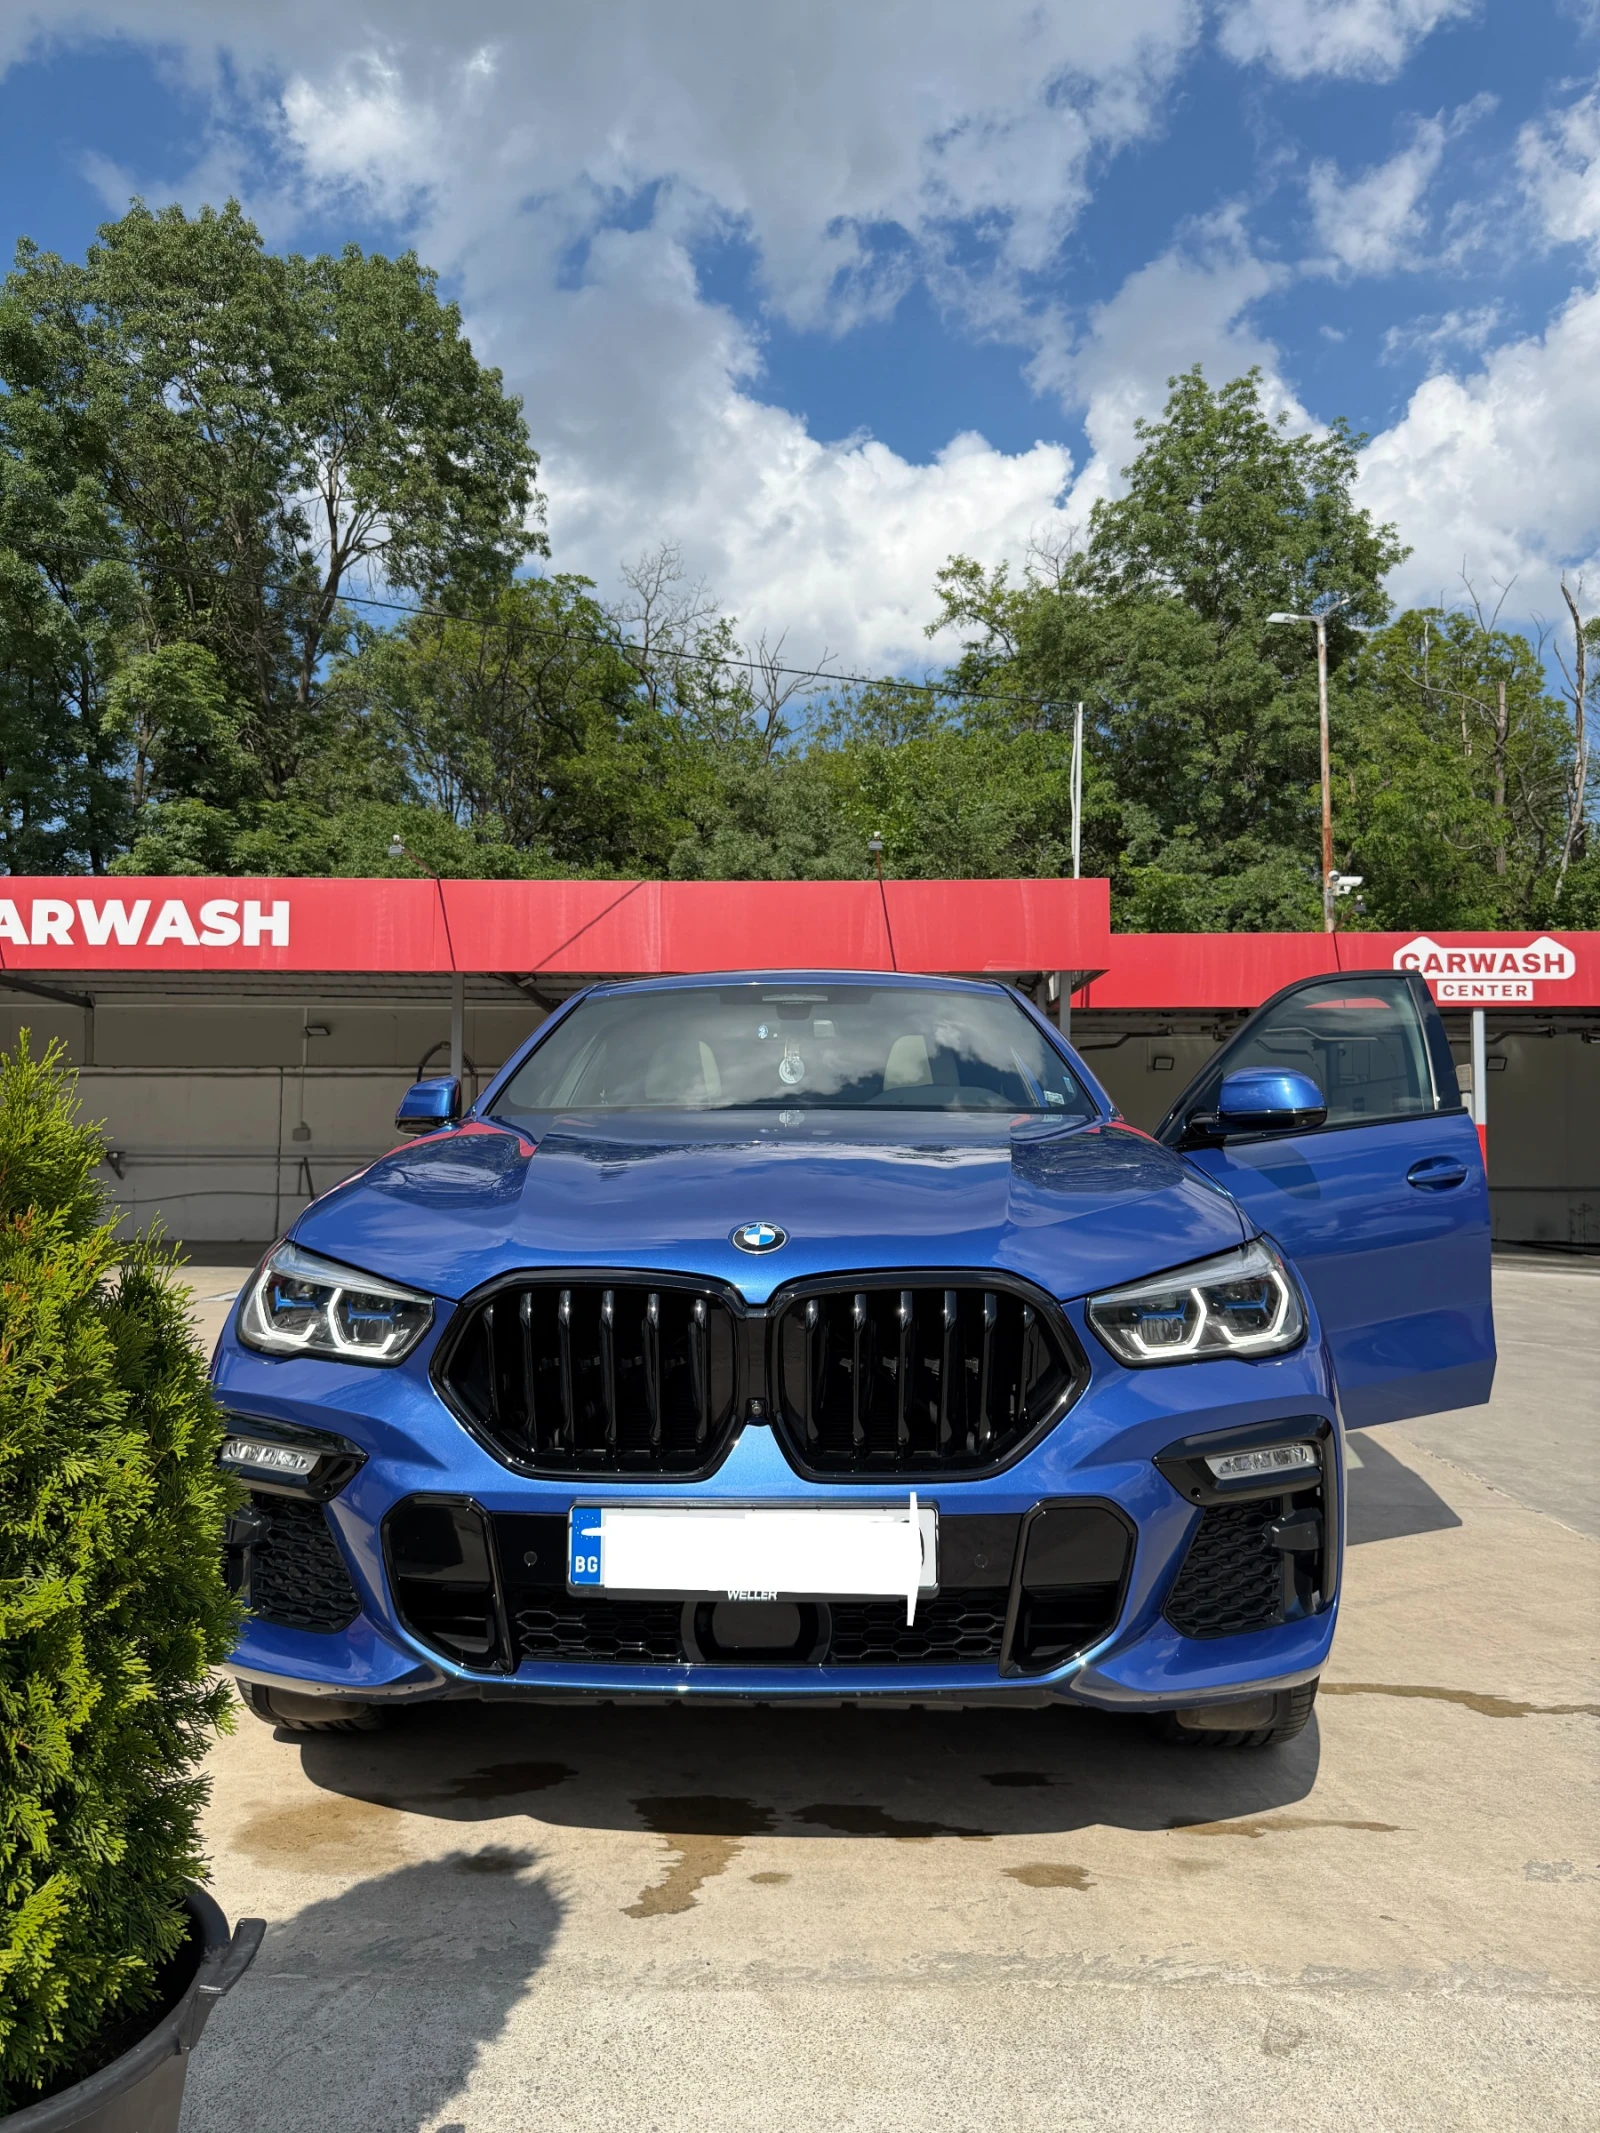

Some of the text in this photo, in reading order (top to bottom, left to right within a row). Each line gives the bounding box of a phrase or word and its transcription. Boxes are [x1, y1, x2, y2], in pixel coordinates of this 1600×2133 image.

[1400, 953, 1565, 973] CARWASH
[1442, 984, 1528, 997] CENTER
[575, 1555, 598, 1573] BG
[727, 1590, 778, 1601] WELLER
